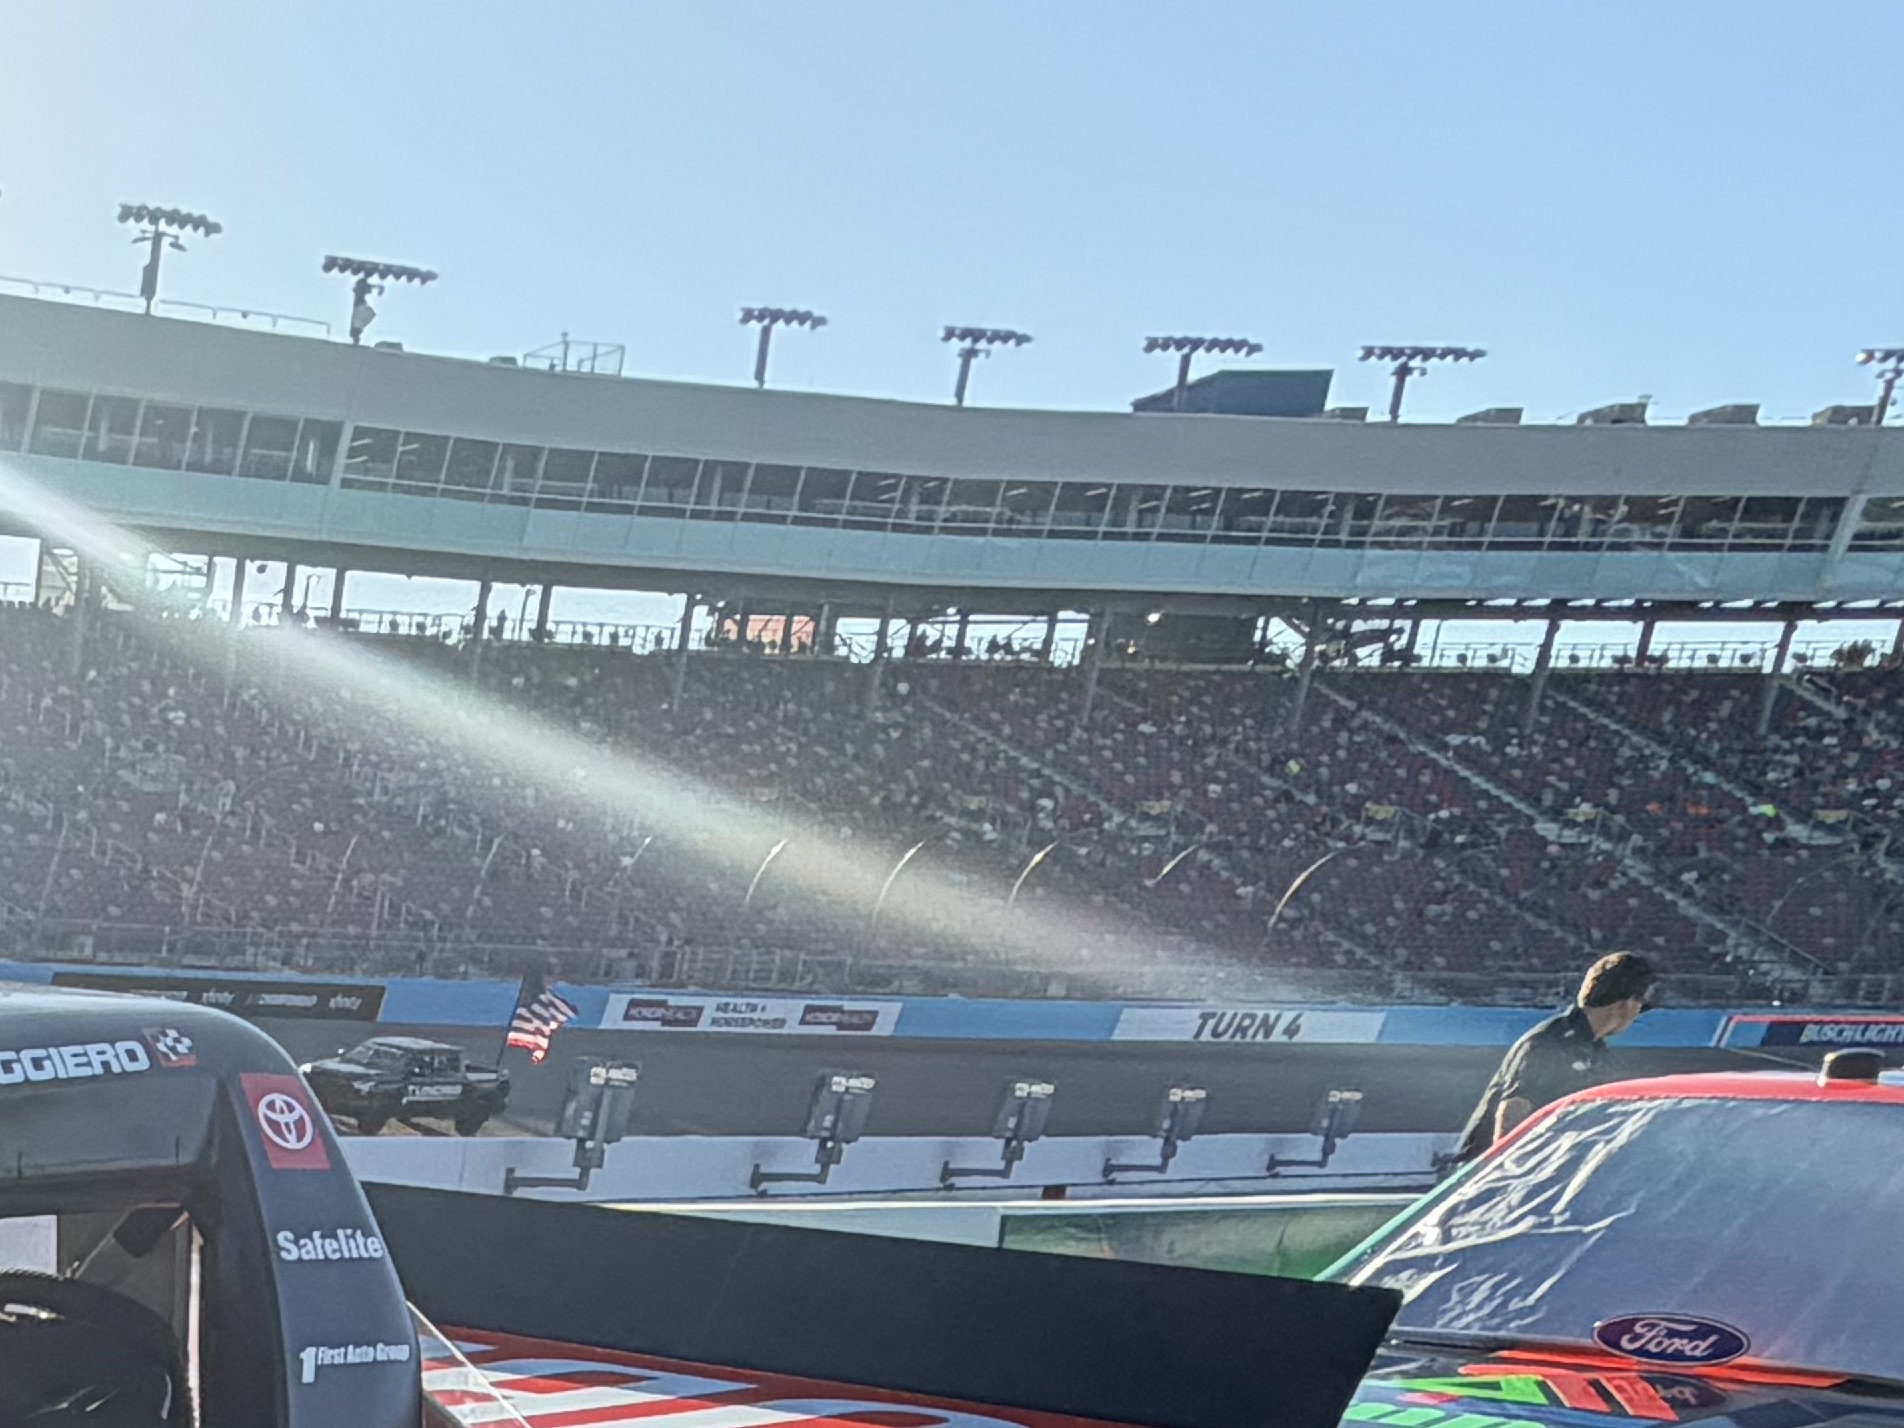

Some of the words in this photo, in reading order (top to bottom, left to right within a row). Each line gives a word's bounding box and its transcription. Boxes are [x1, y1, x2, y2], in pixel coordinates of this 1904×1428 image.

[1193, 1012, 1282, 1041] TURN
[1282, 1013, 1304, 1040] 4
[277, 1229, 385, 1261] Safelite
[1620, 1320, 1723, 1357] Ford
